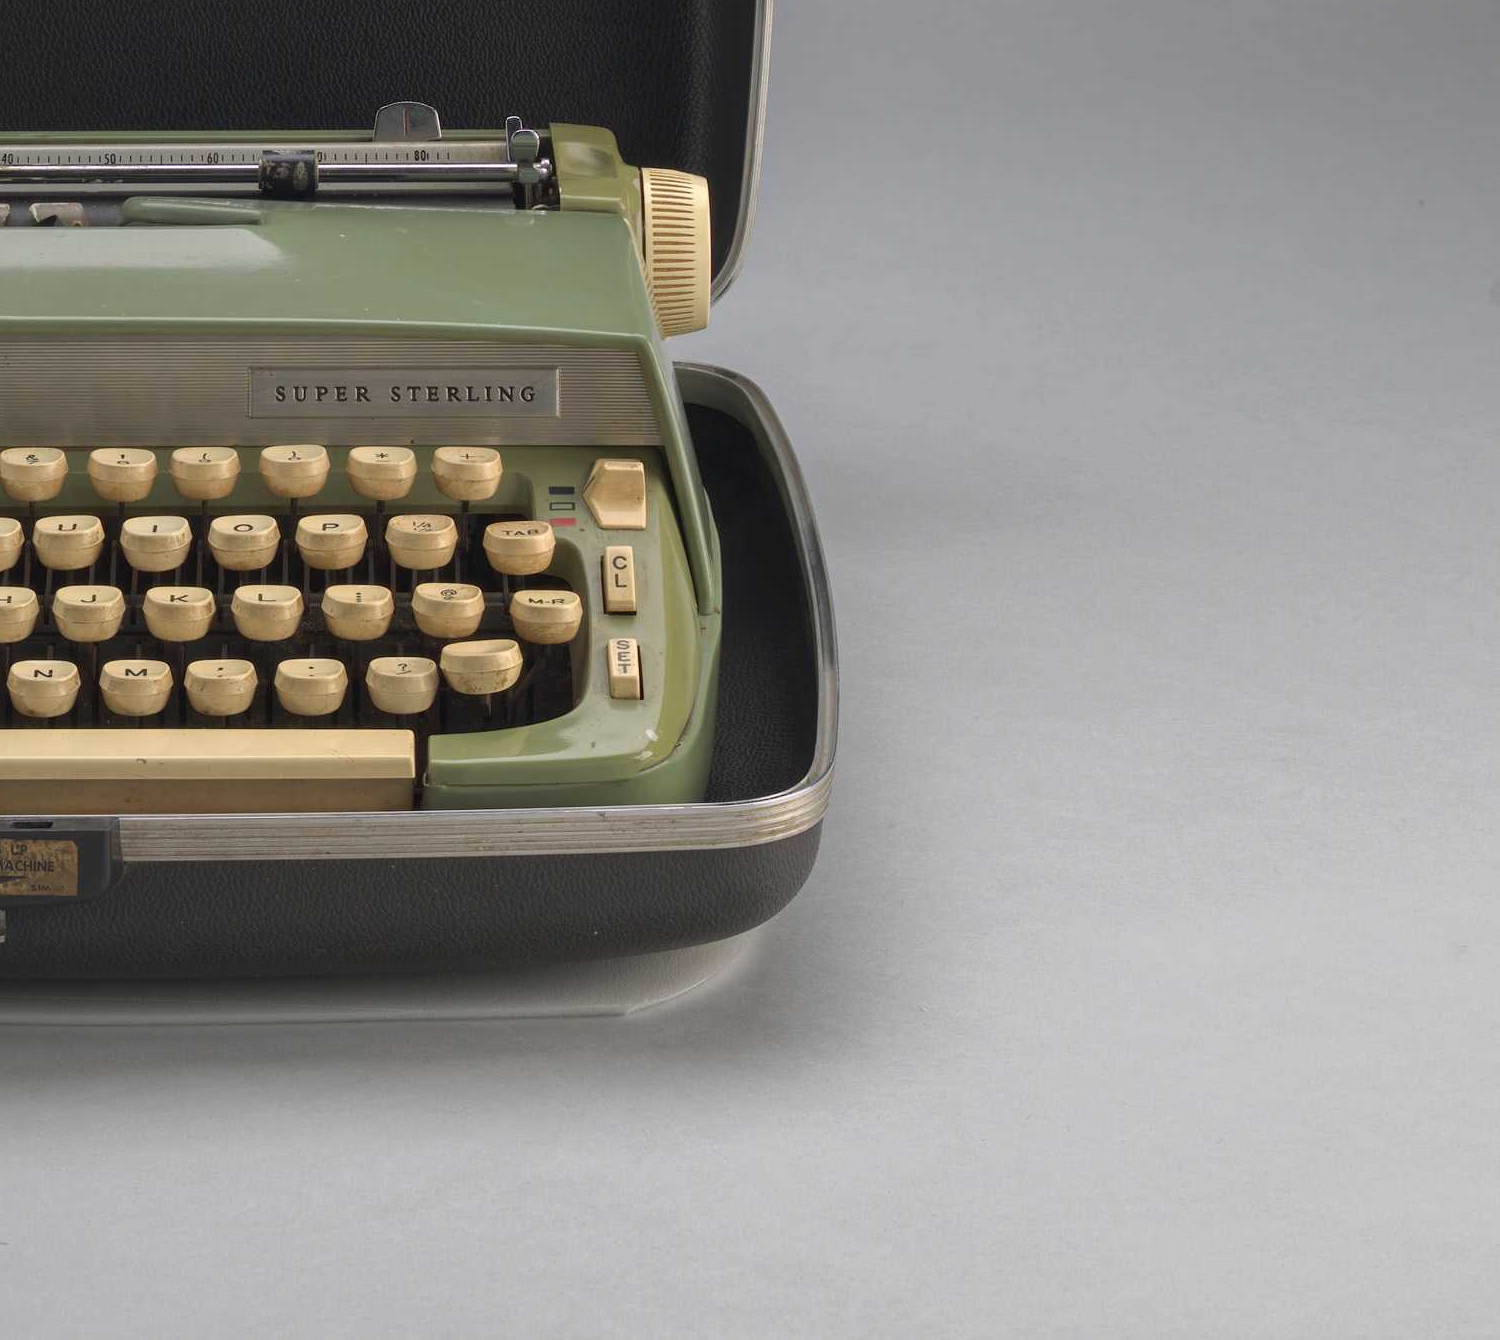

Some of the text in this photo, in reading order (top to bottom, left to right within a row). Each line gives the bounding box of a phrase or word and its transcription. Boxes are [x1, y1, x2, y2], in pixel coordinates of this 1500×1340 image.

[1, 153, 14, 165] 40
[104, 153, 117, 165] 50
[206, 153, 219, 165] 60
[414, 150, 426, 162] 80
[275, 385, 537, 403] SUPER STERLING
[57, 523, 78, 532] U
[233, 523, 254, 533] O
[321, 522, 340, 532] P
[80, 594, 97, 604] J
[169, 594, 189, 603] K
[257, 593, 277, 603] L
[616, 639, 630, 674] SET
[33, 669, 54, 678] N
[124, 668, 148, 677] M
